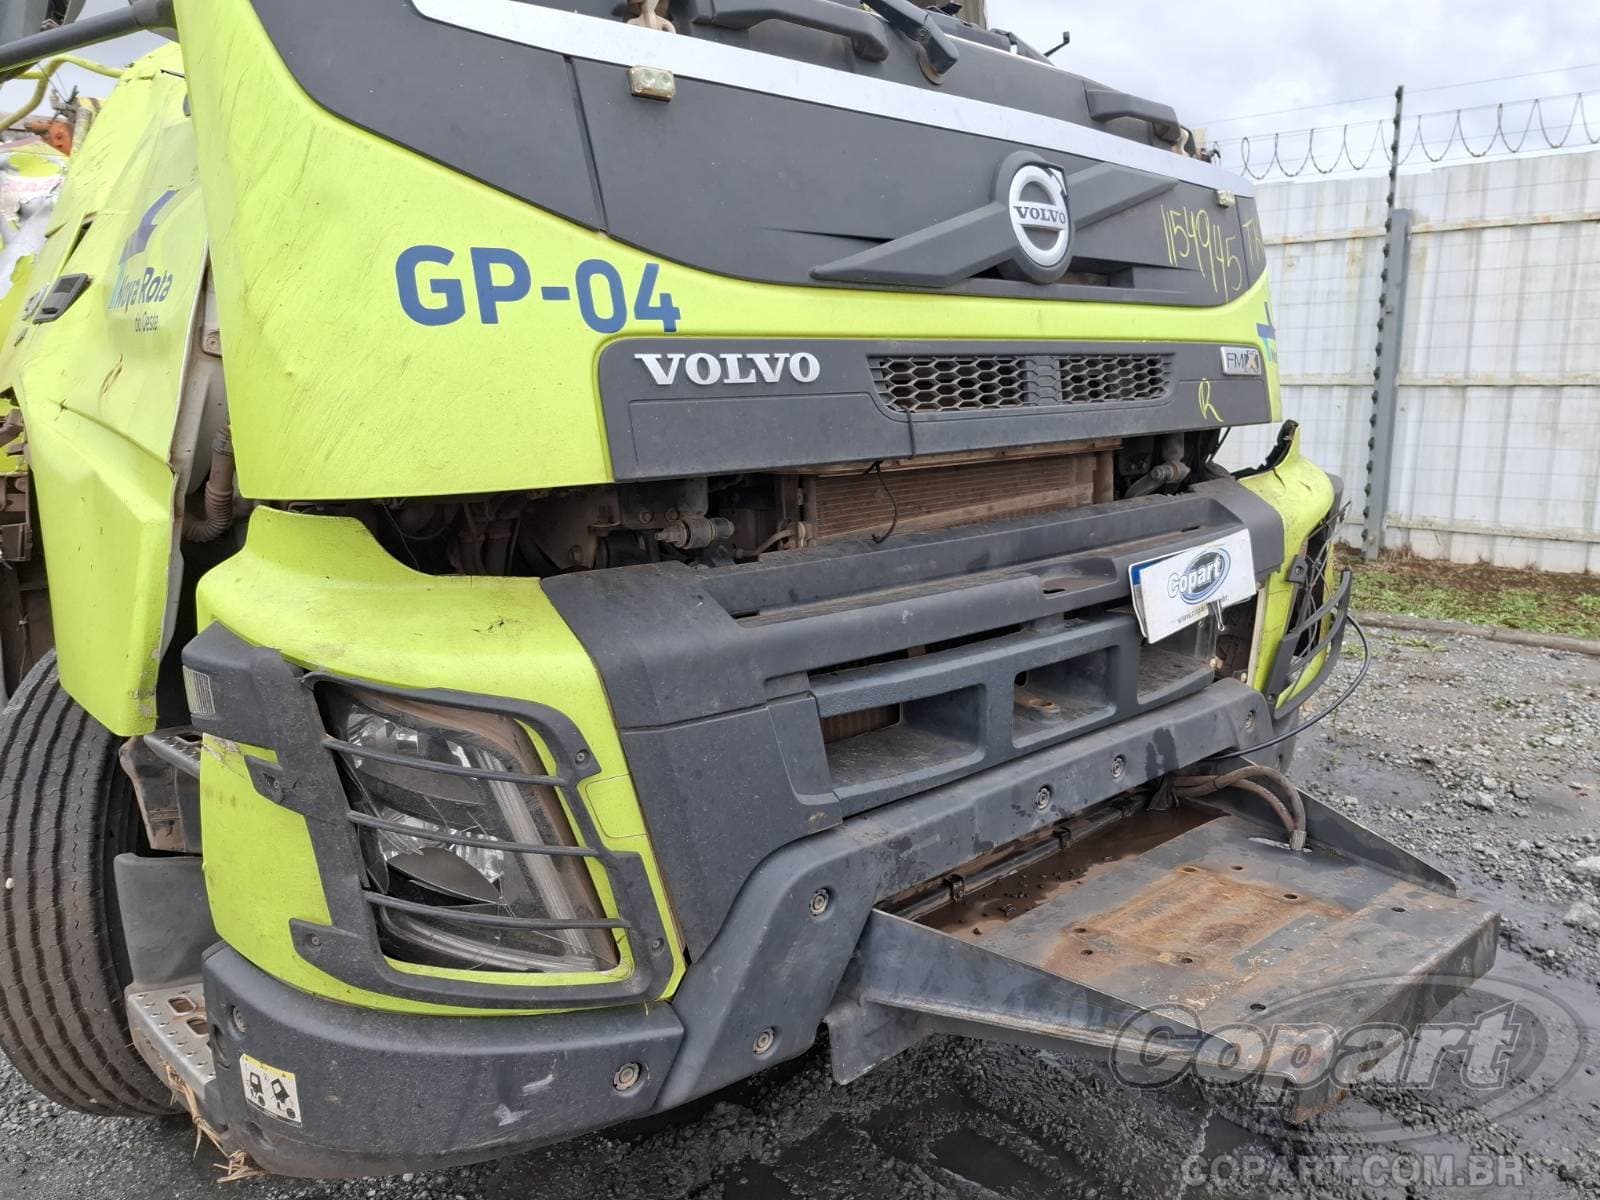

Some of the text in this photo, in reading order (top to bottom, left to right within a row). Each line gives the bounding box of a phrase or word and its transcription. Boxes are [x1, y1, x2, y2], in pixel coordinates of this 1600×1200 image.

[1013, 205, 1067, 225] VOLVO
[138, 266, 174, 304] Rota
[395, 244, 682, 334] GP-04
[633, 352, 821, 385] VOLVO
[1167, 553, 1223, 599] Copart
